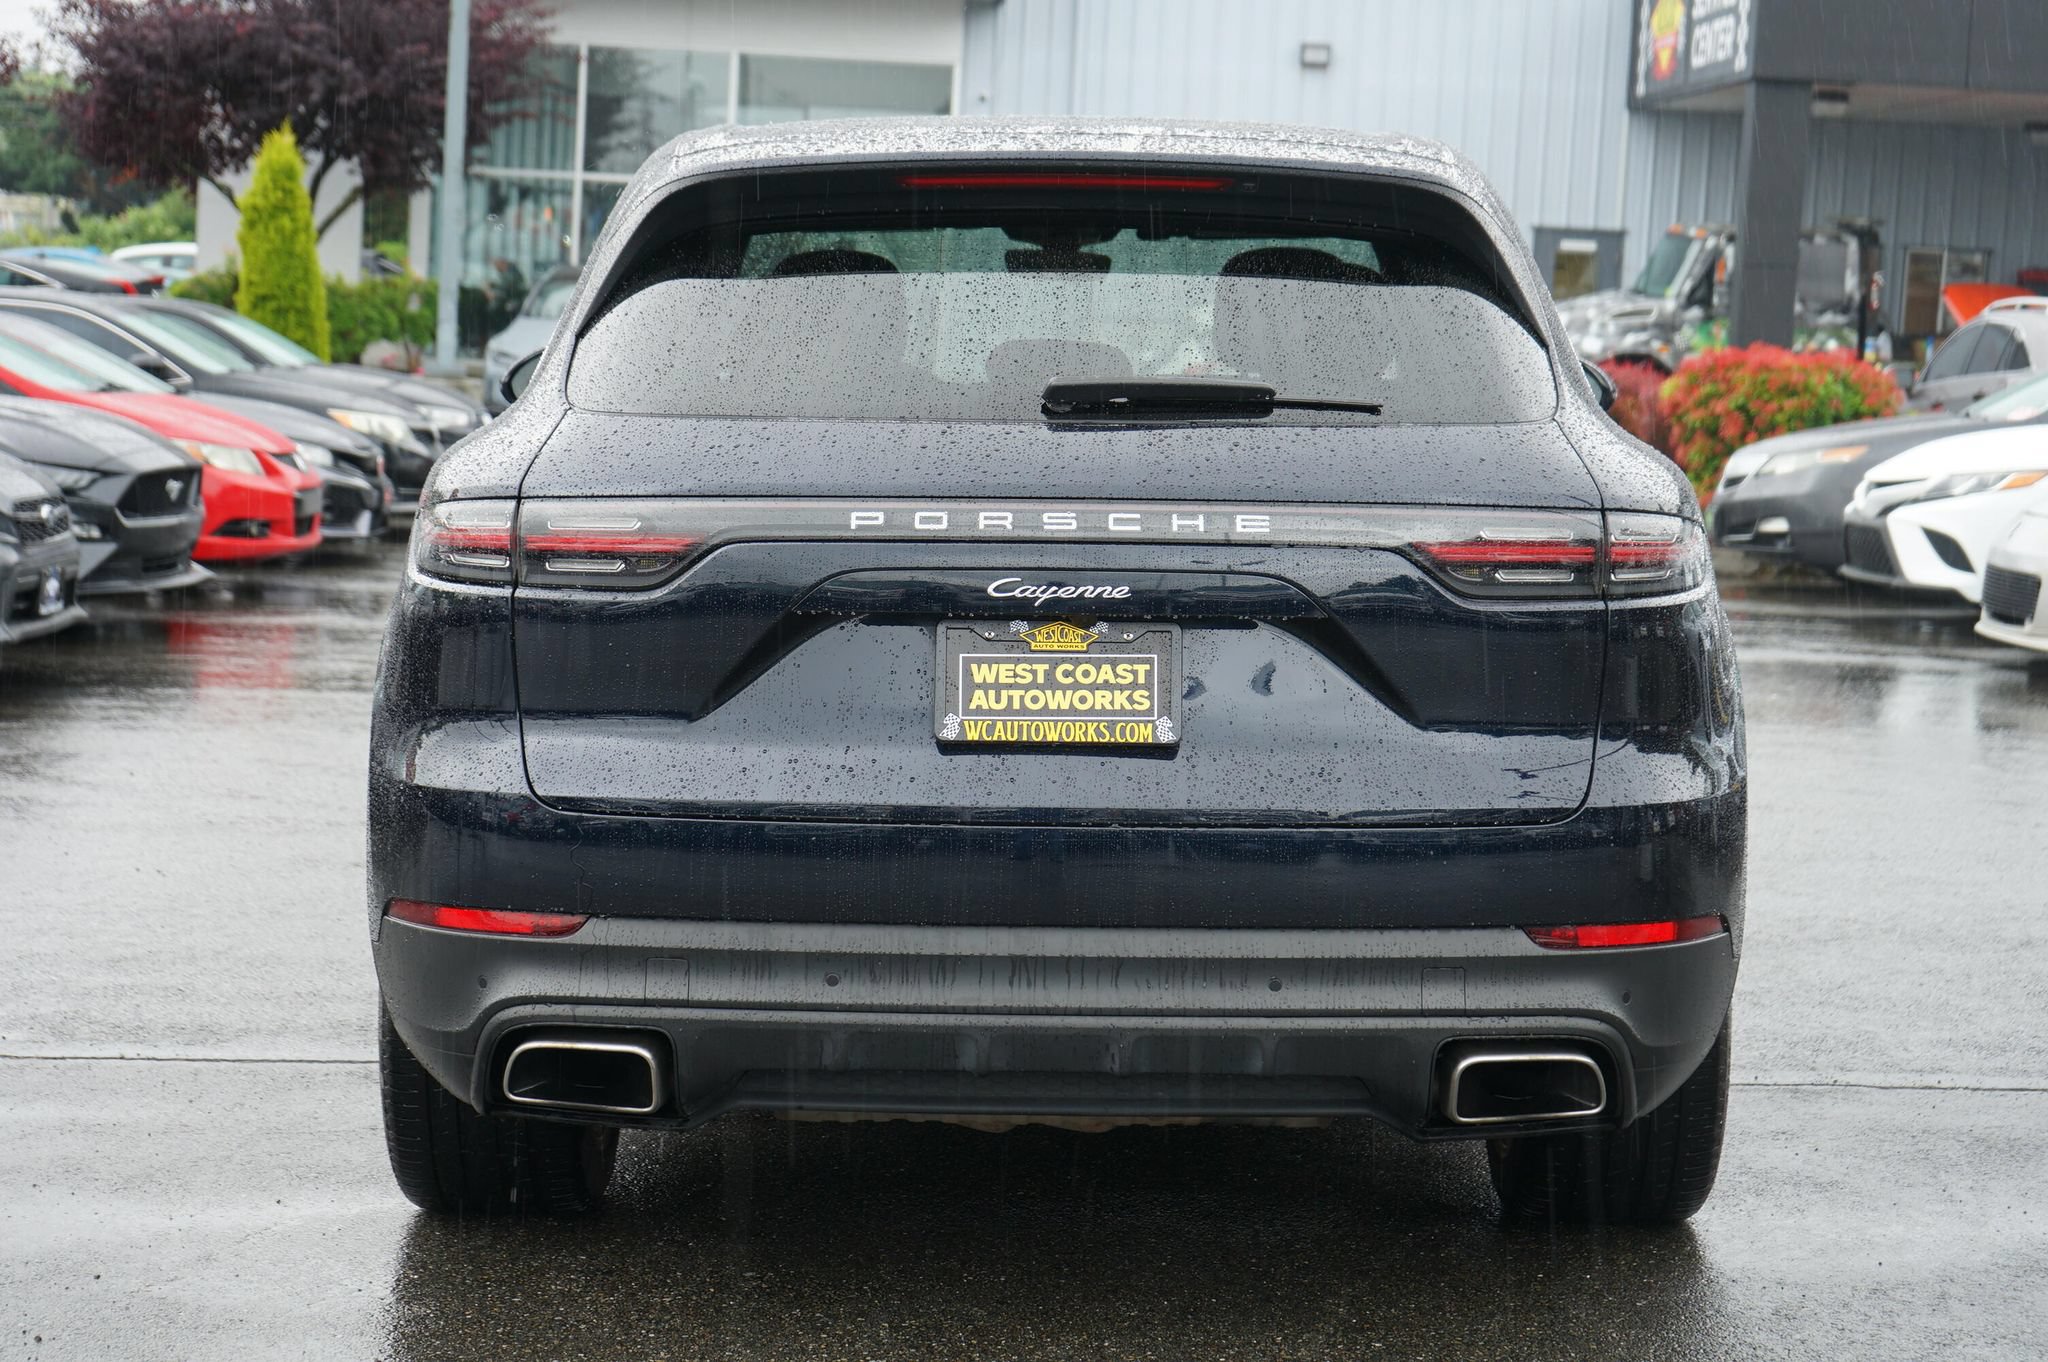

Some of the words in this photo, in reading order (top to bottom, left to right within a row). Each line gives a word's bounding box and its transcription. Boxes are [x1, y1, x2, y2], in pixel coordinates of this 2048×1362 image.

[1691, 14, 1736, 69] CENTER
[850, 511, 1271, 532] PORSCHE
[987, 577, 1132, 607] Cayenne
[970, 663, 1050, 684] WEST
[1055, 664, 1151, 684] COAST
[968, 689, 1151, 711] AUTOWORKS
[963, 720, 1153, 743] WCAUTOWORKS.COM
